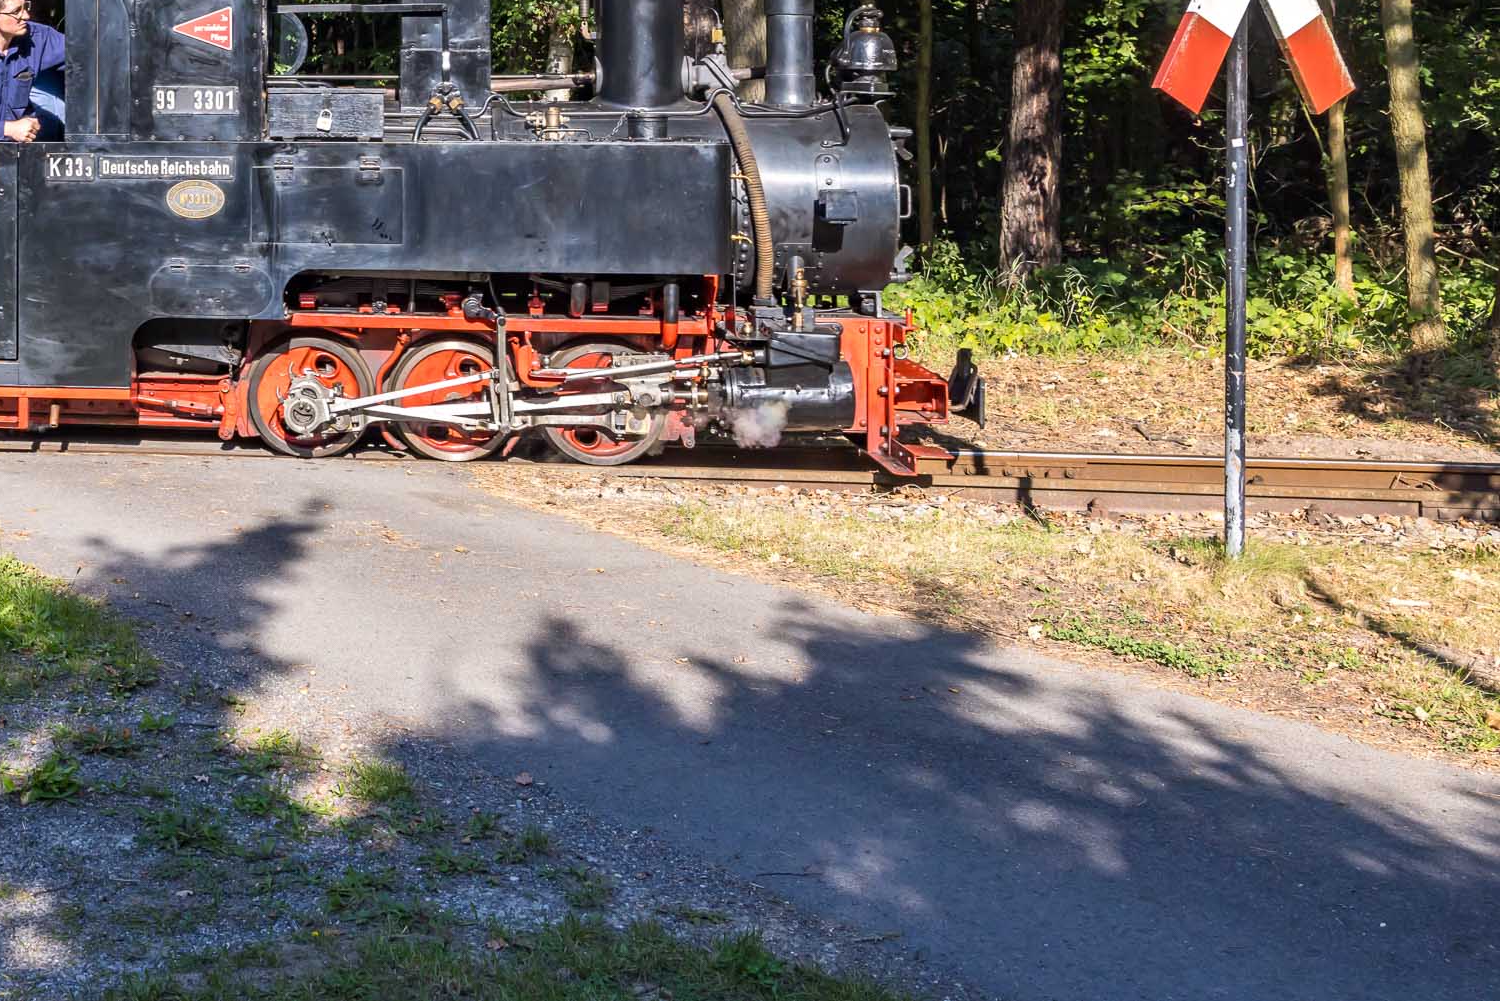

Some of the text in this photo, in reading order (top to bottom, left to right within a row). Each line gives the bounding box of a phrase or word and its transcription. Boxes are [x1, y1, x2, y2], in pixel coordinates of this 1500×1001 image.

[156, 90, 234, 110] 99 3301
[49, 157, 62, 177] K
[102, 160, 230, 176] Deutsche Reichsbahn
